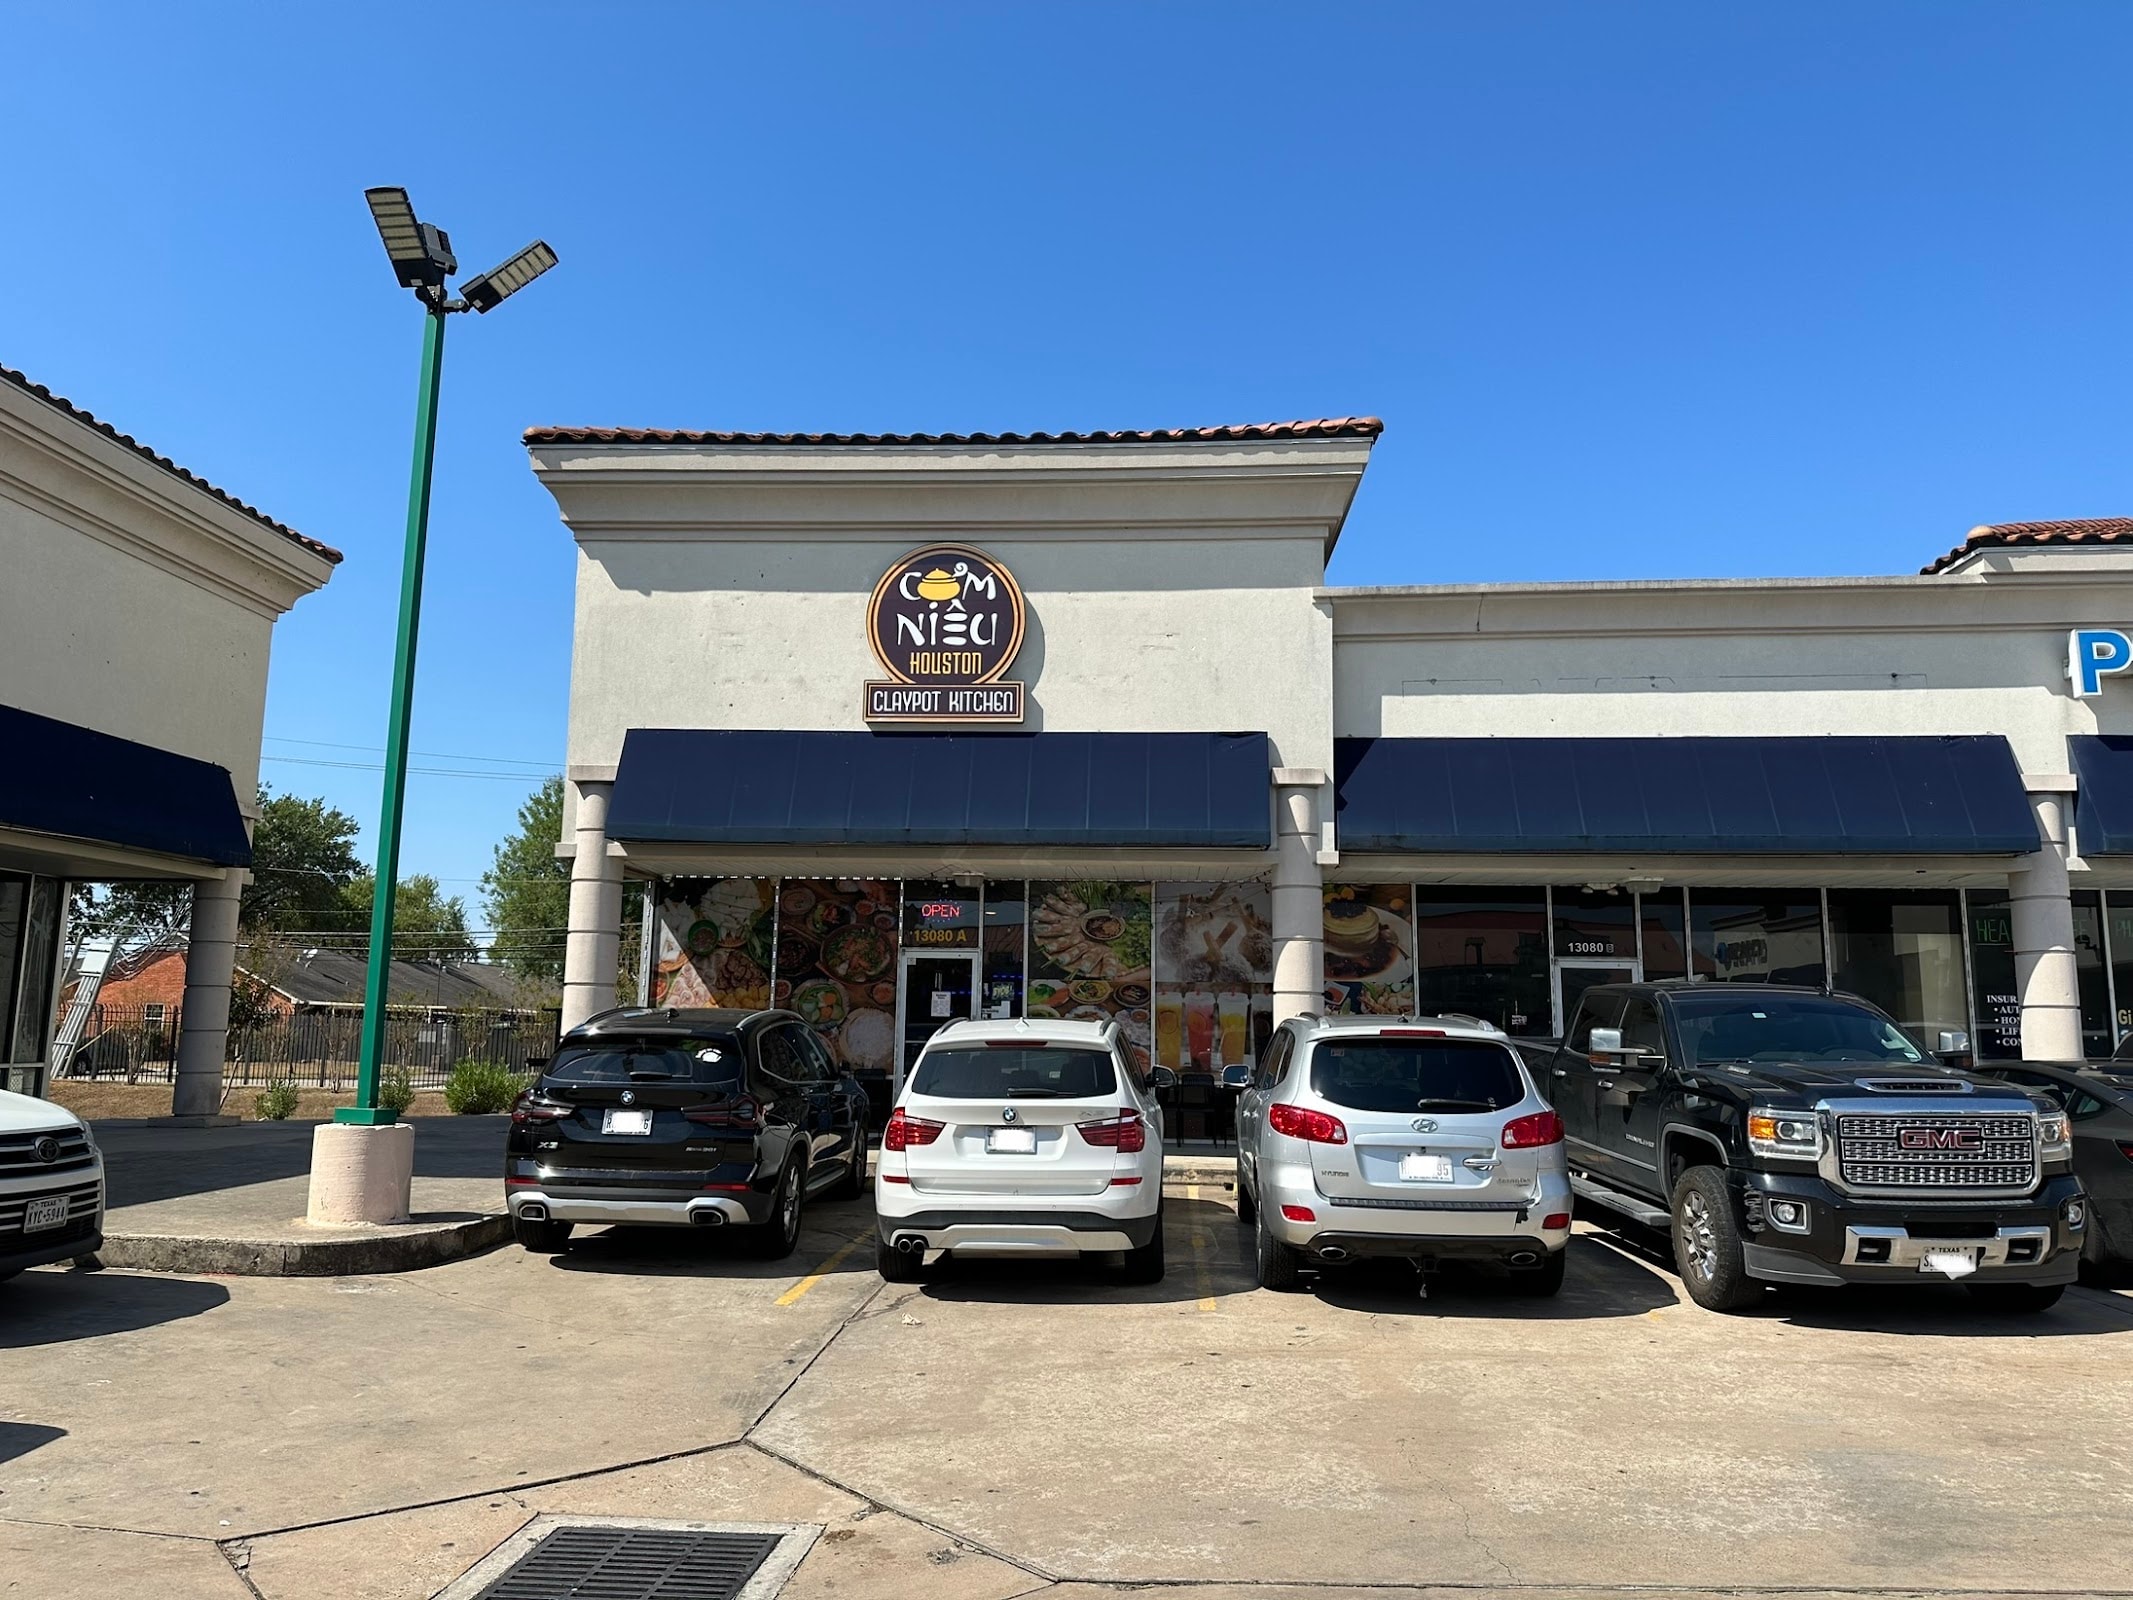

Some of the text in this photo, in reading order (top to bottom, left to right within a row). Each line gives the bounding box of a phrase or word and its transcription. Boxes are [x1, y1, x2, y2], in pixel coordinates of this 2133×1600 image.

[910, 652, 982, 674] HOUSTON
[873, 690, 1013, 712] CLAYPOT KITCHEN
[921, 904, 961, 917] OPEN
[914, 930, 967, 942] 13080 A
[1567, 942, 1604, 953] 13080
[1900, 1129, 1981, 1149] GMC
